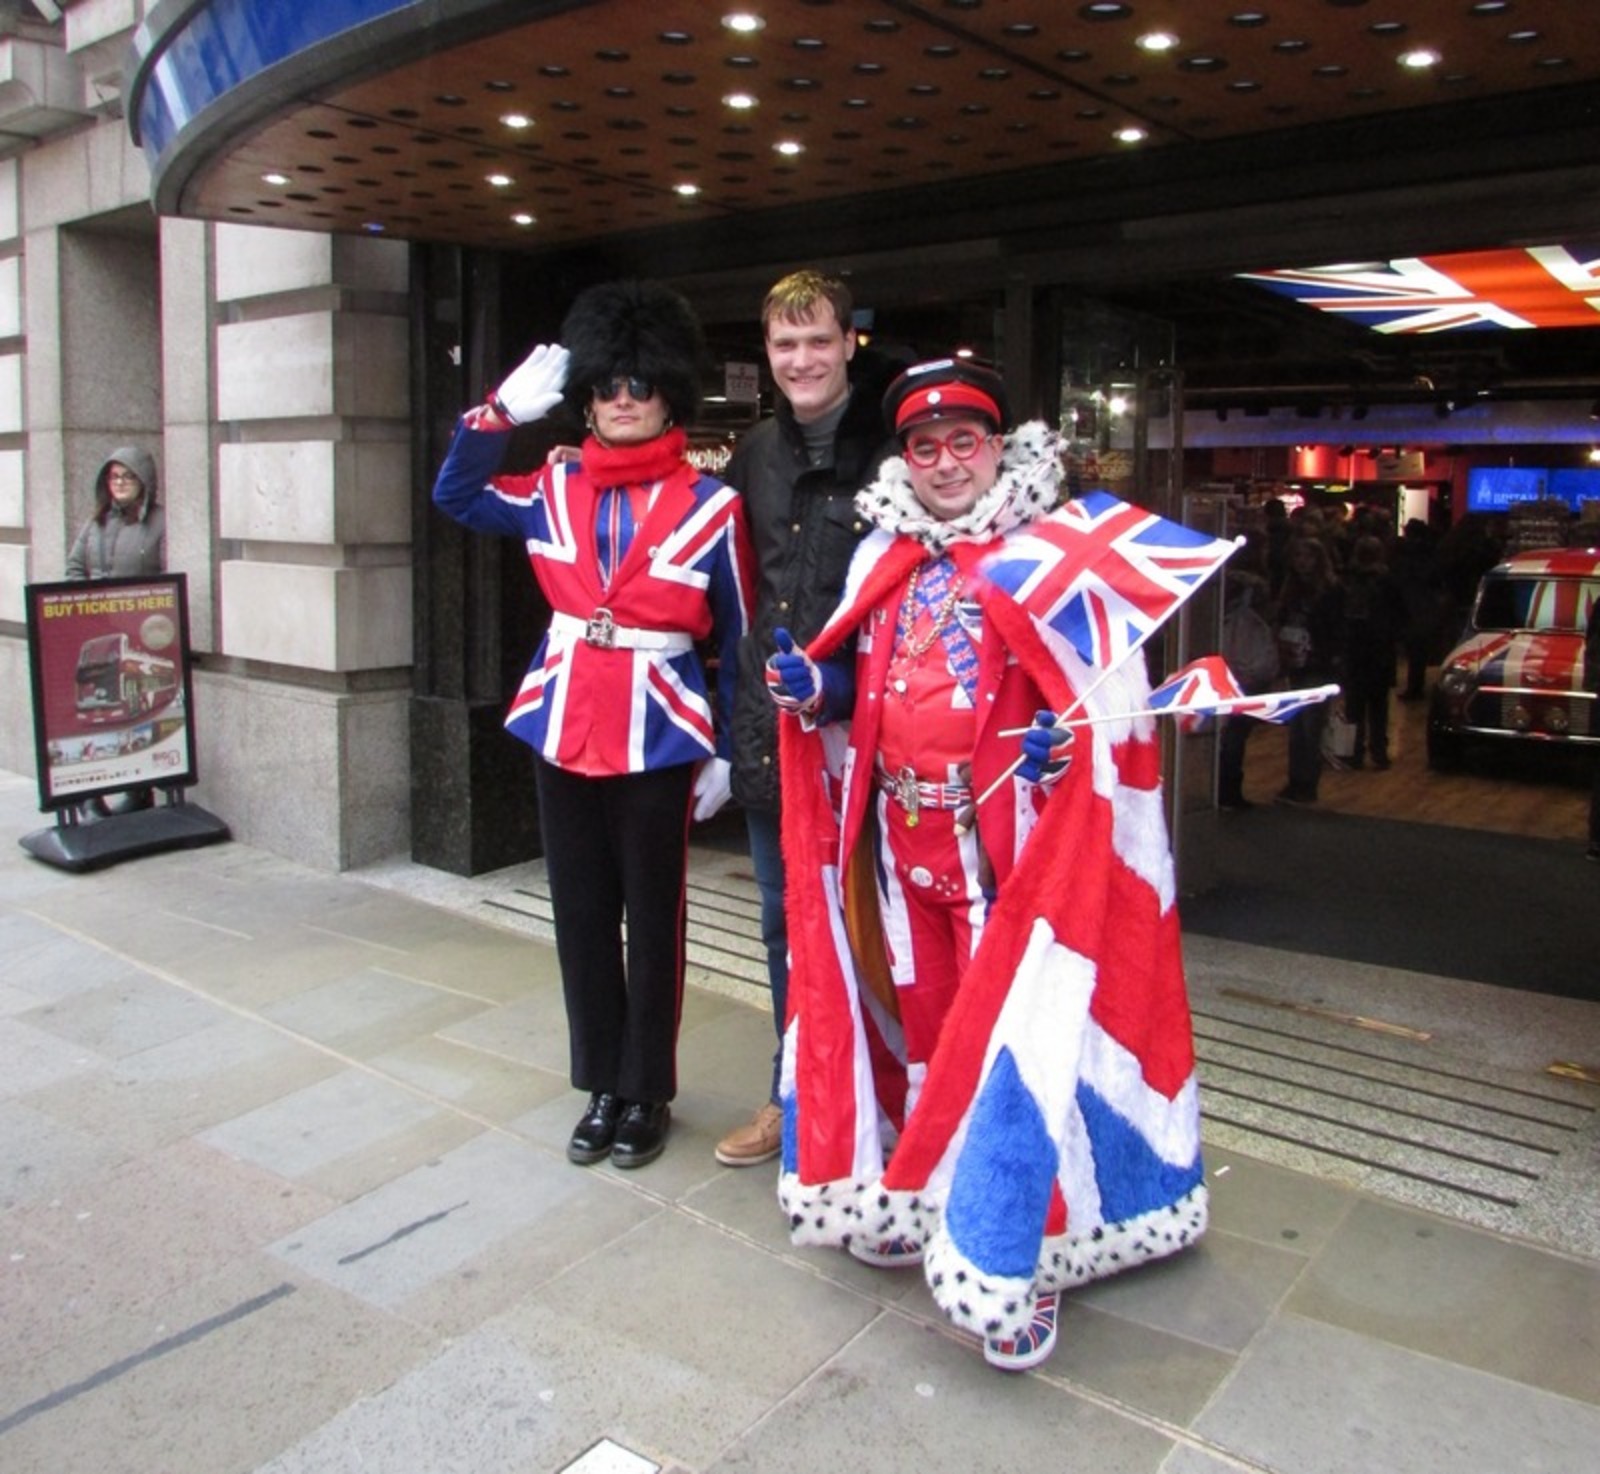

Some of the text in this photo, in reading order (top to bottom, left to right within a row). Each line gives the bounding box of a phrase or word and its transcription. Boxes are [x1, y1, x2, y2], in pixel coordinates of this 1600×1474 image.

[43, 596, 174, 618] BUY TICKETS HERE
